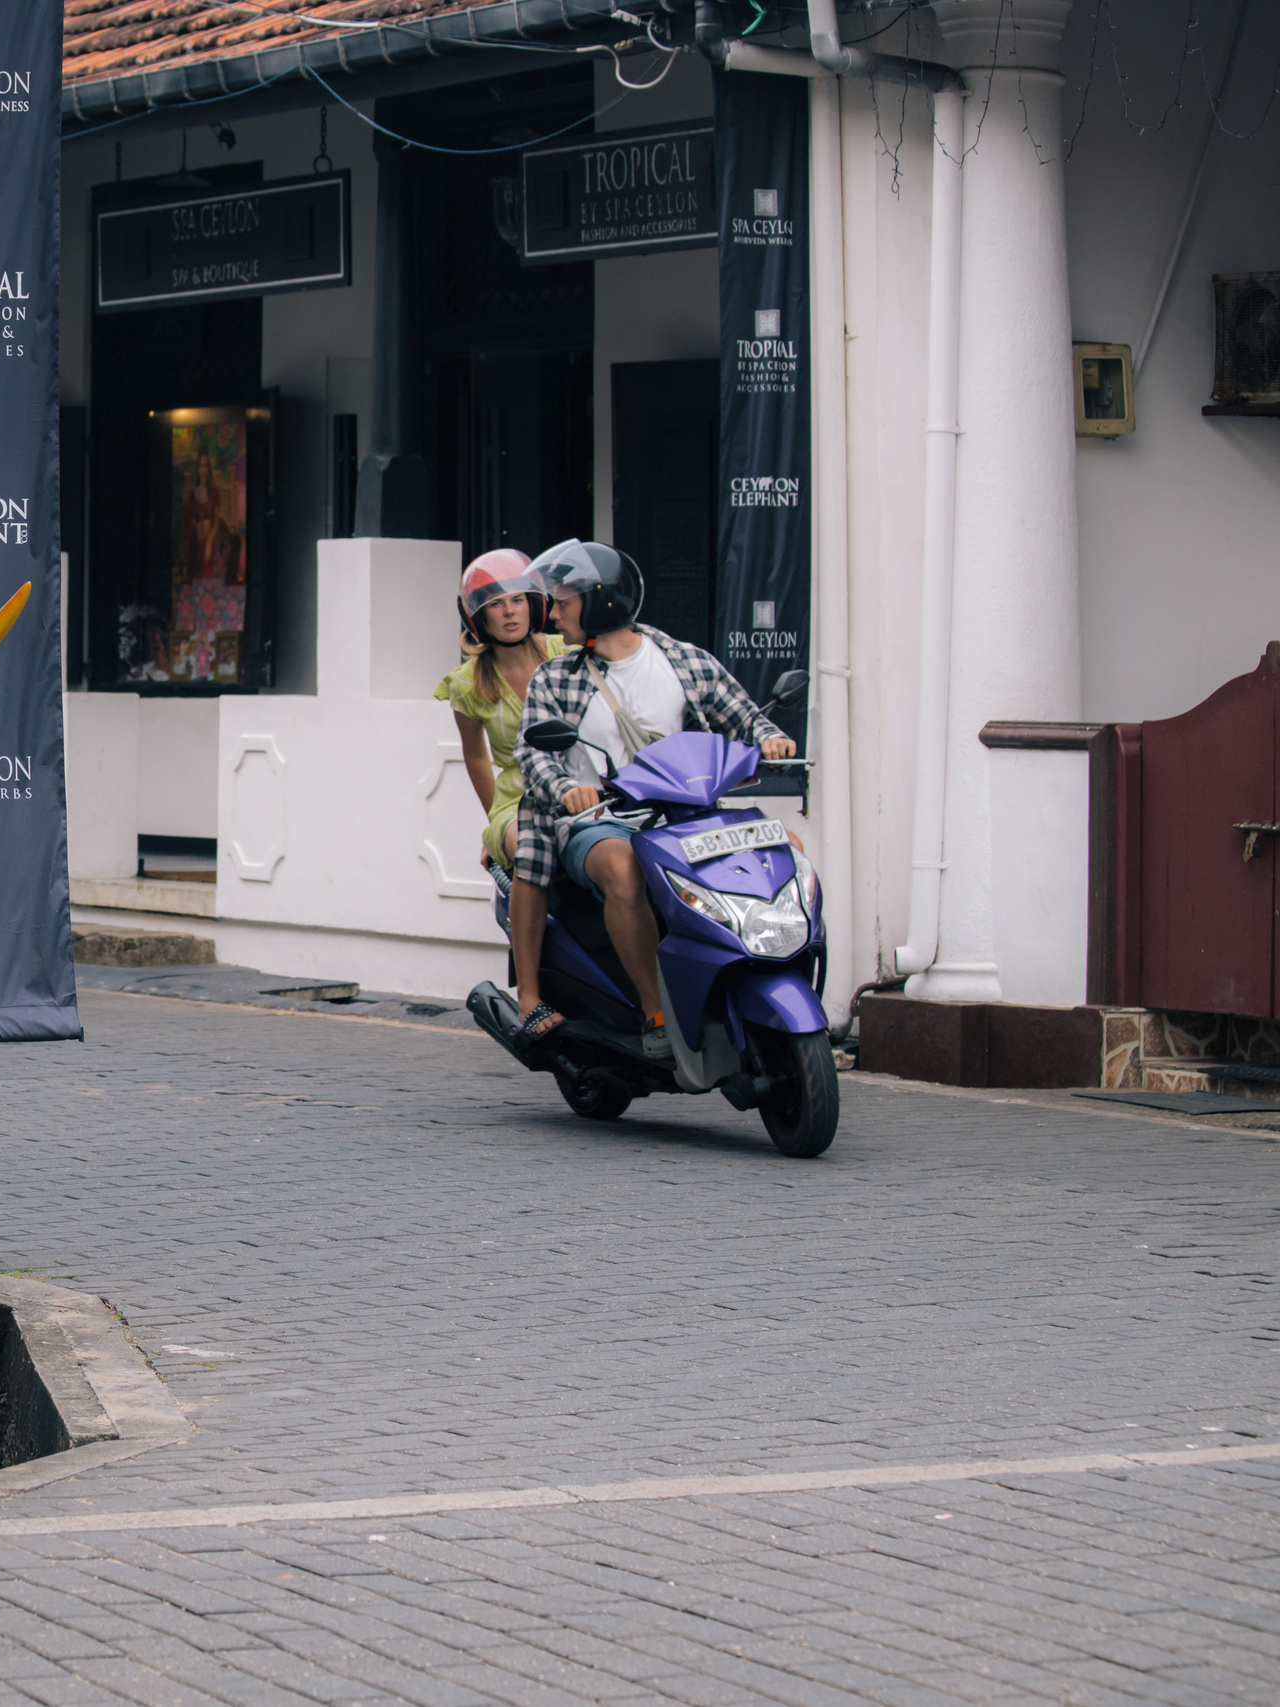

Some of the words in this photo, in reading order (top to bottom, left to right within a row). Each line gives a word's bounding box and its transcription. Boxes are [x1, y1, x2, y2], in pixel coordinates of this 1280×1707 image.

[582, 139, 696, 193] TROPICAL
[581, 202, 597, 224] BY
[605, 198, 631, 222] SPA
[635, 190, 698, 217] CEYLON
[172, 207, 198, 241] SPA
[200, 197, 260, 237] CEYLON
[732, 217, 750, 234] SPA
[581, 226, 618, 243] FASHION
[620, 224, 640, 238] AND
[640, 217, 697, 236] ACCESSORIES
[733, 236, 767, 245] AYURVEDA
[203, 259, 259, 283] BOUTIQUE
[2, 325, 15, 339] &
[737, 361, 746, 371] BY
[748, 361, 765, 371] SPA
[782, 372, 789, 382] &
[731, 477, 799, 492] CEYLON
[731, 492, 799, 507] ELEPHANT
[728, 631, 747, 648] SPA
[751, 631, 797, 648] CEYLON
[767, 650, 796, 659] HERBS
